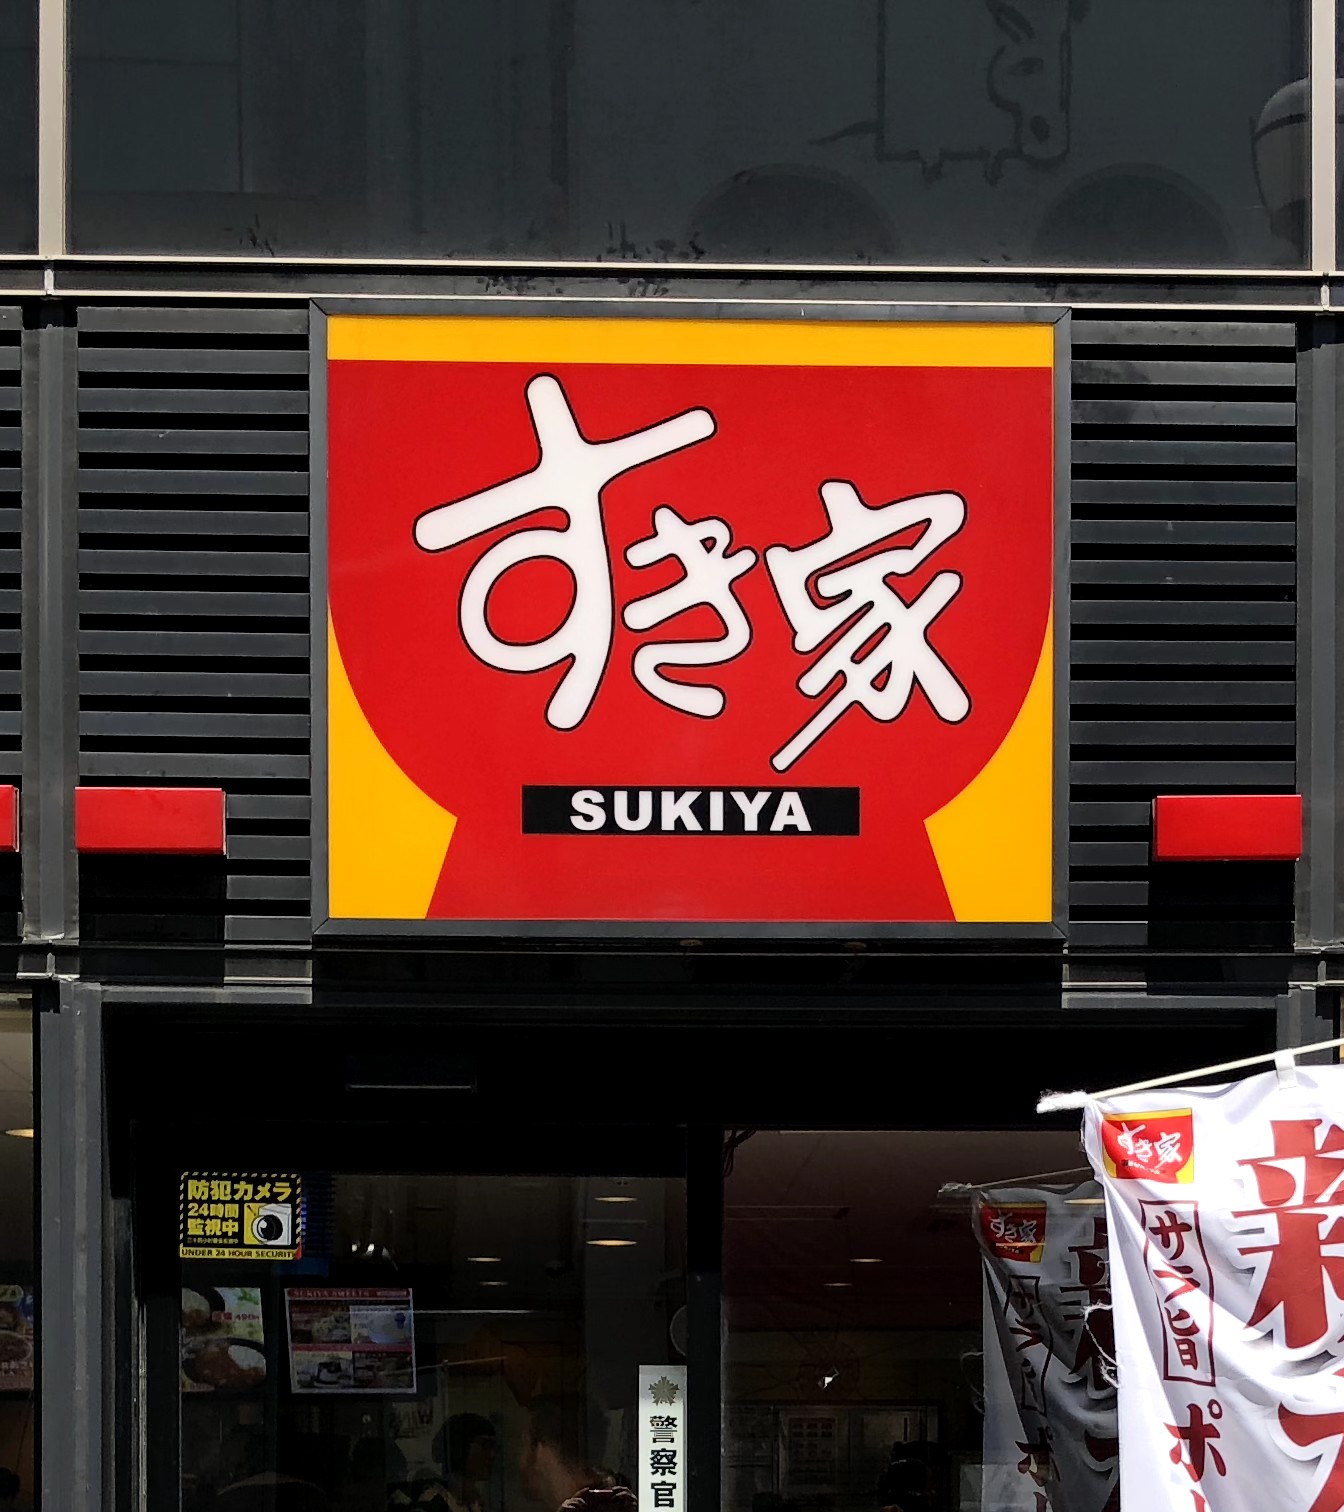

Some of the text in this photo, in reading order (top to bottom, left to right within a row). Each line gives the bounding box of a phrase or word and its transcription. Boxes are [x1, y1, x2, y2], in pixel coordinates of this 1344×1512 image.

[413, 372, 971, 773] すき家
[569, 789, 812, 832] SUKIYA
[1116, 1121, 1183, 1170] すき家
[187, 1179, 292, 1202] 防犯カメラ
[187, 1202, 239, 1219] 24時間
[187, 1218, 239, 1236] 監視中
[181, 1248, 213, 1257] UNDER
[215, 1249, 226, 1257] 24
[228, 1249, 253, 1258] HOUR
